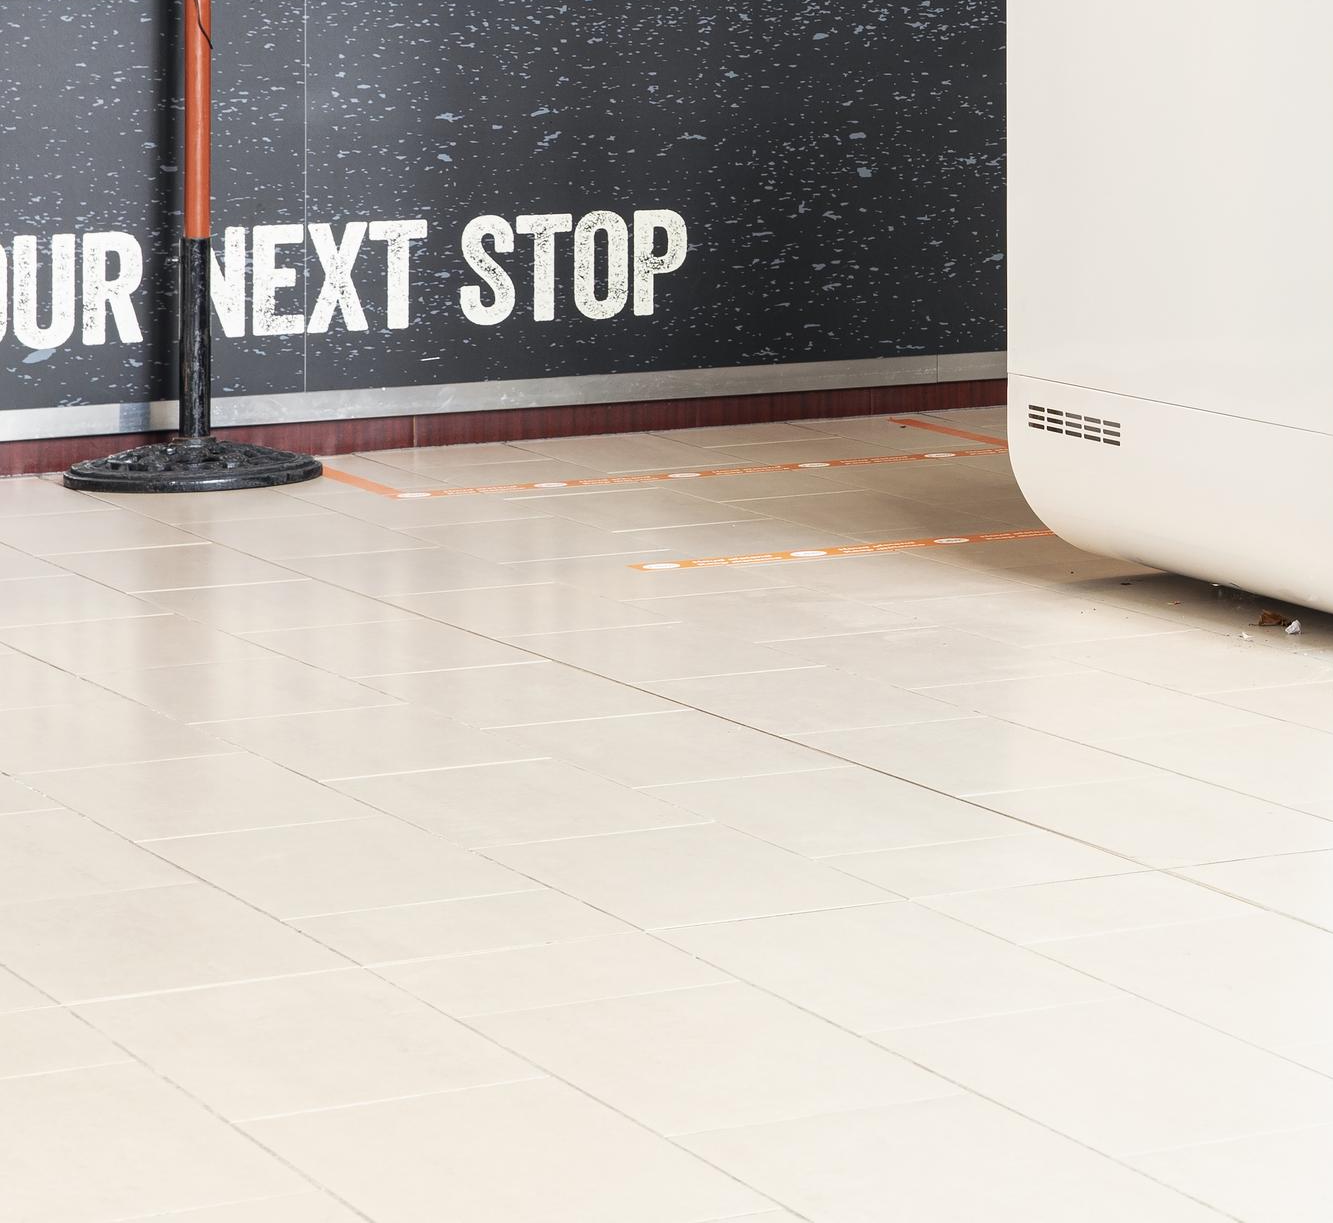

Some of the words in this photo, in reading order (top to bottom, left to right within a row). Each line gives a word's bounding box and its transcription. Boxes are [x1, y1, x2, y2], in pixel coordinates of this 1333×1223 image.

[0, 231, 143, 350] UR
[210, 218, 428, 338] NEXT
[459, 209, 688, 327] STOP
